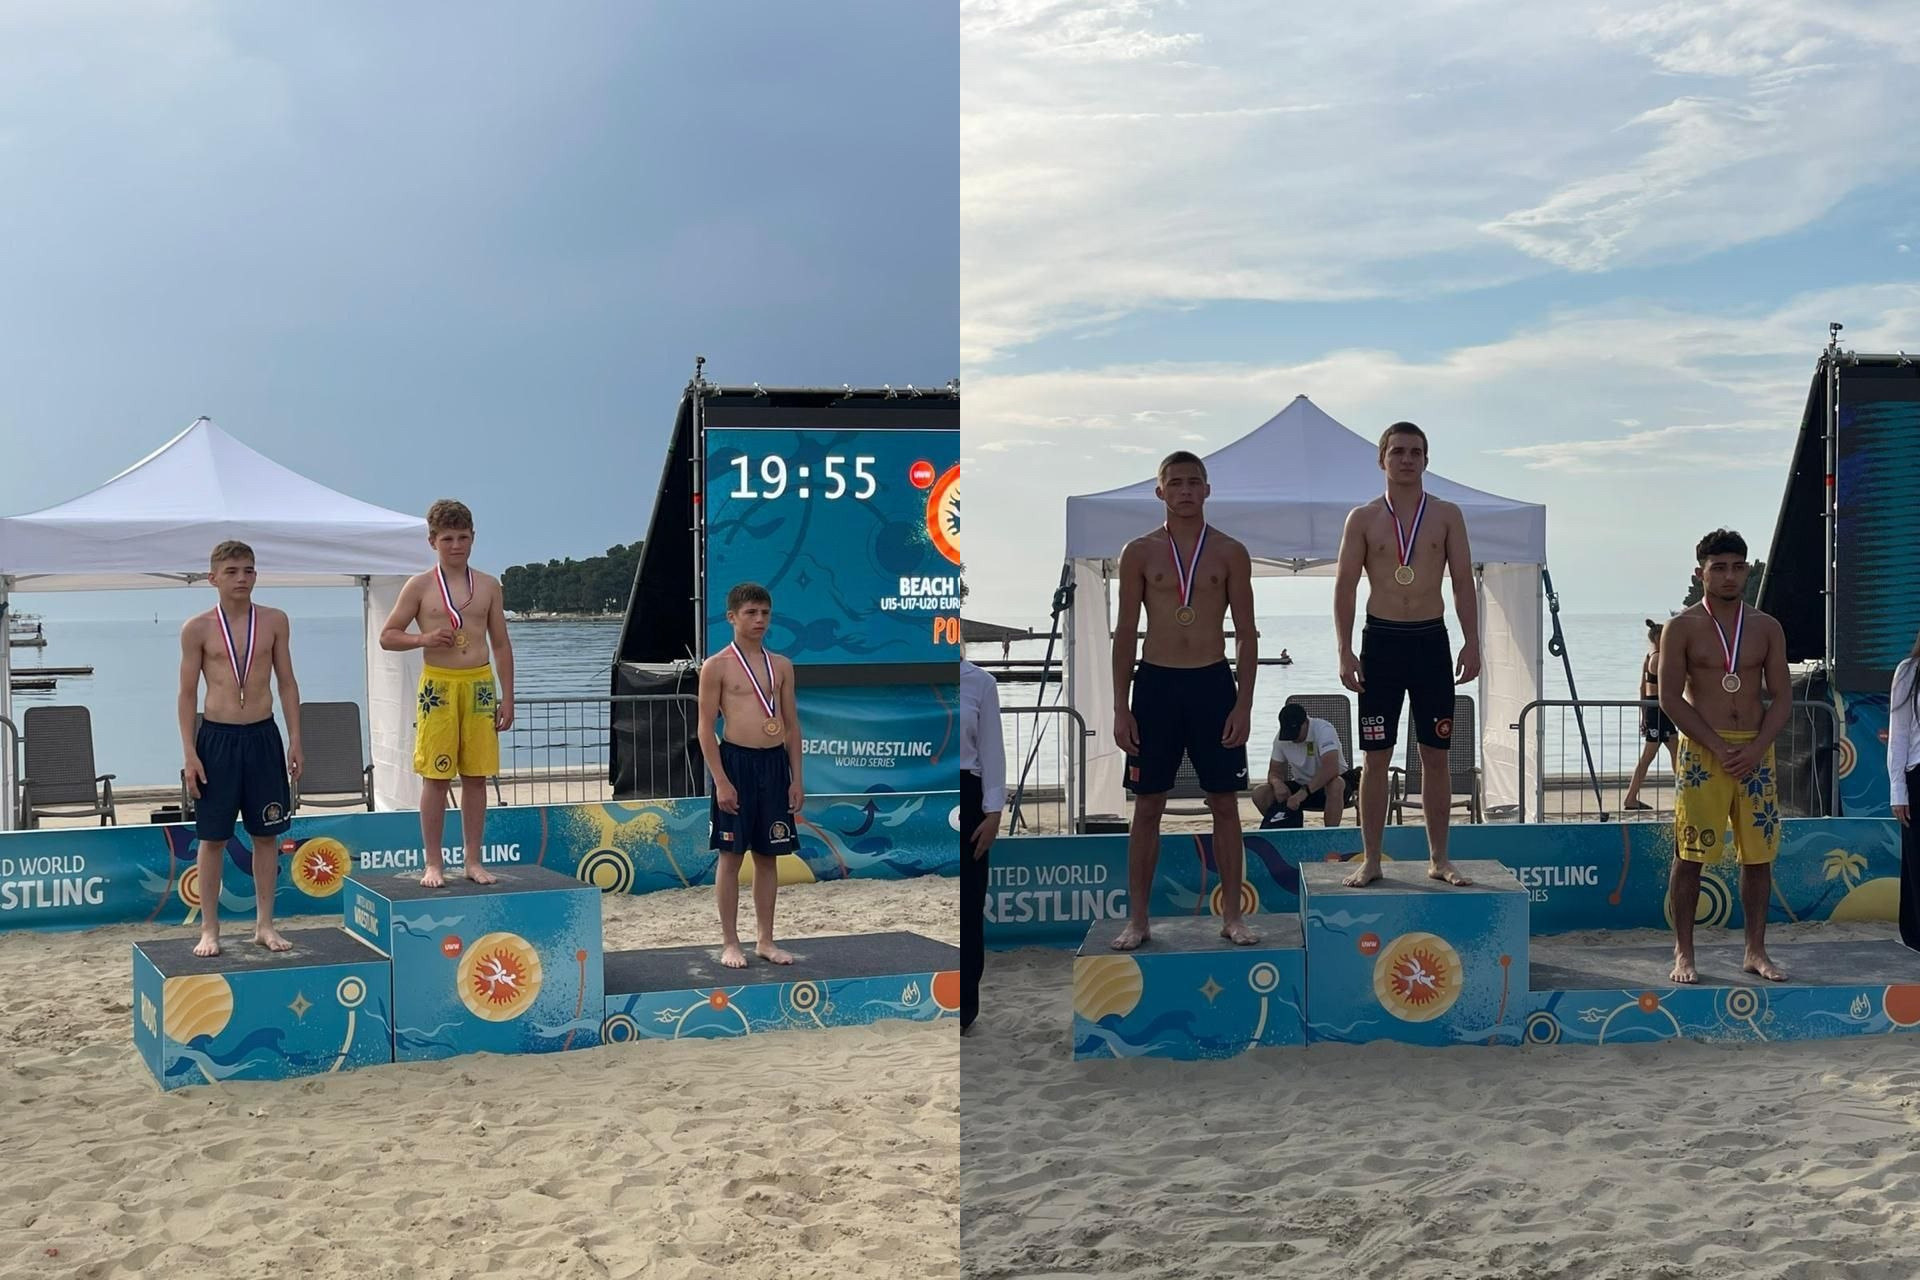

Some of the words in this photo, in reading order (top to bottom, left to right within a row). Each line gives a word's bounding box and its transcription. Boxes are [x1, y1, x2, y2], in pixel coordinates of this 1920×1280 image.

[730, 455, 877, 500] 19:55
[899, 576, 955, 596] BEACH
[880, 597, 938, 610] U15-U17-U20
[933, 616, 960, 645] PO
[1361, 715, 1384, 726] GEO
[801, 739, 848, 755] BEACH
[851, 741, 932, 756] WRESTLING
[835, 756, 866, 767] WORLD
[868, 757, 895, 768] SERIES
[19, 855, 85, 876] WORLD
[360, 849, 418, 869] BEACH
[422, 843, 521, 865] RELING
[988, 866, 1031, 887] ITED
[1035, 864, 1108, 885] WORLD
[0, 877, 104, 910] STLING
[1528, 889, 1549, 902] IES
[983, 889, 1128, 924] RESTLING
